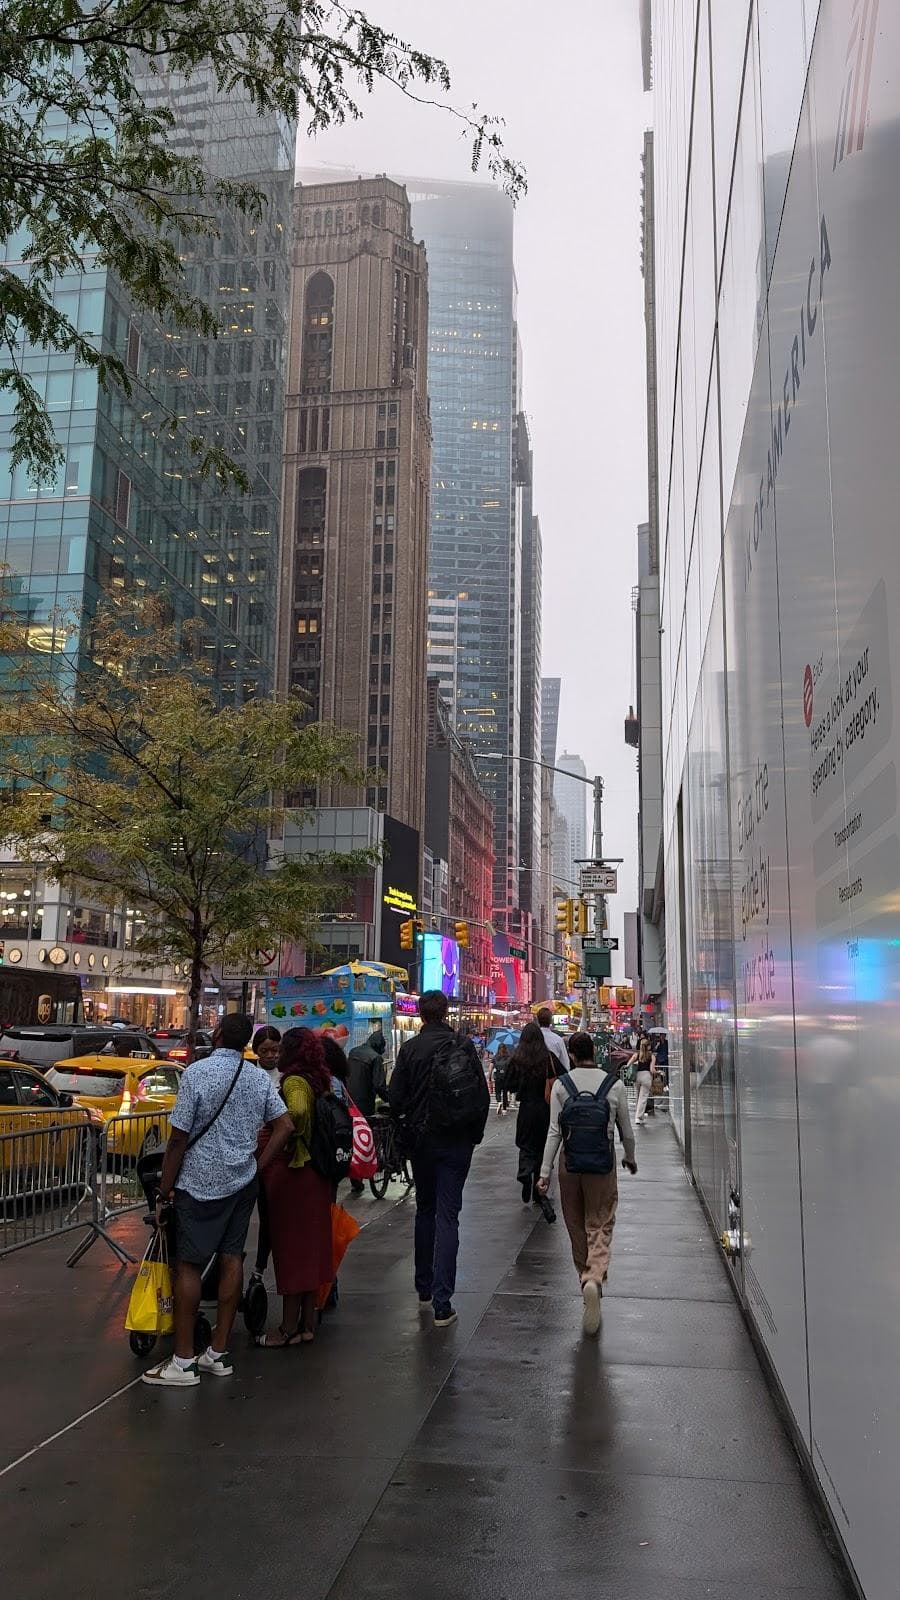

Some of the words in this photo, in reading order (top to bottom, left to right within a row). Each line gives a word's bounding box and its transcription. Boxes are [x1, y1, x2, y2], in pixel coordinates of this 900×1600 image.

[767, 214, 831, 508] AMERICA
[831, 682, 845, 726] look
[846, 671, 853, 704] at
[853, 646, 869, 700] your
[812, 747, 836, 798] spending
[845, 687, 880, 750] category.
[755, 757, 769, 824] the
[760, 846, 770, 926] by
[759, 932, 775, 1001] side
